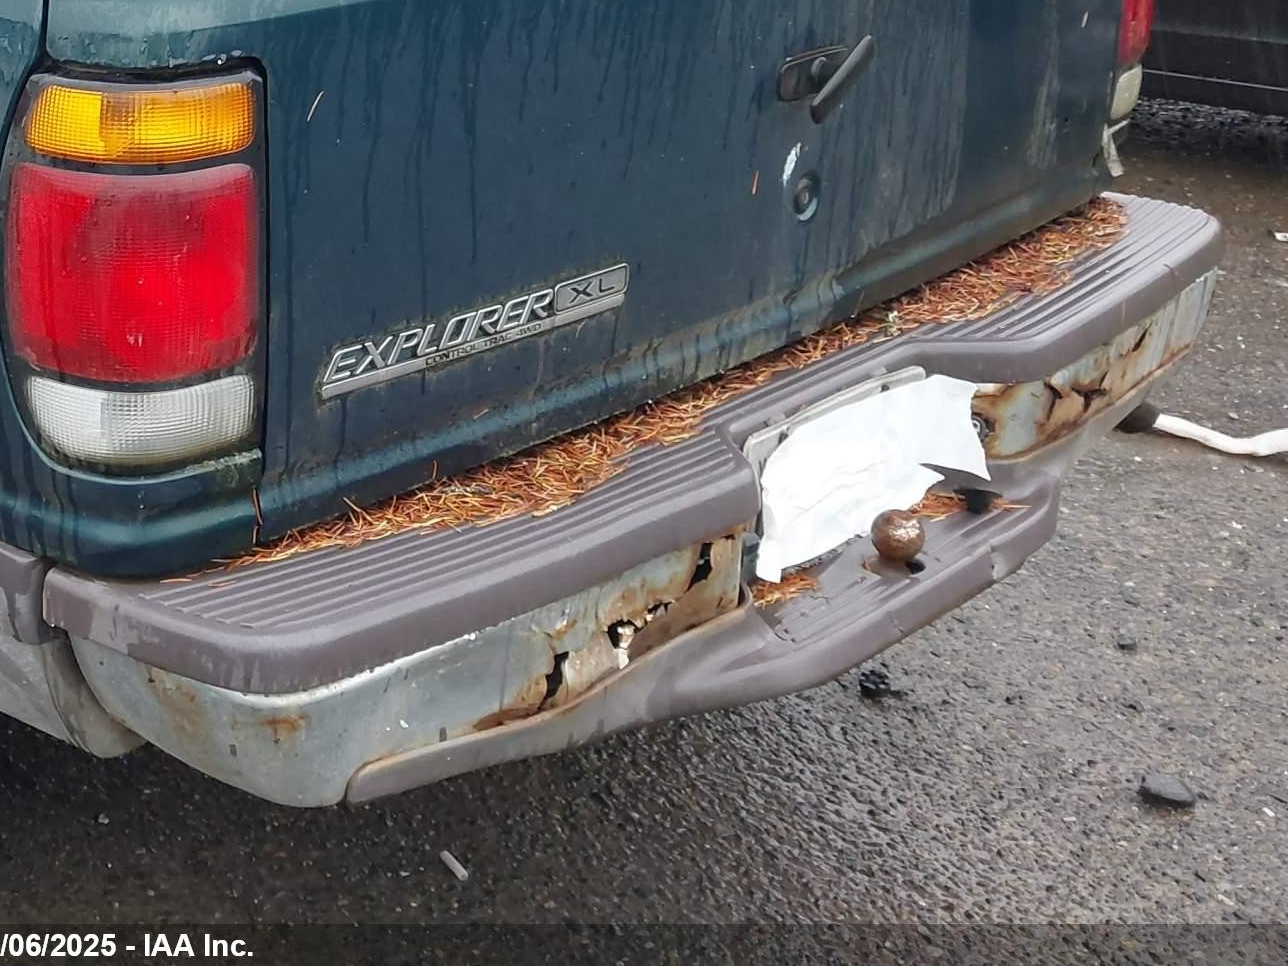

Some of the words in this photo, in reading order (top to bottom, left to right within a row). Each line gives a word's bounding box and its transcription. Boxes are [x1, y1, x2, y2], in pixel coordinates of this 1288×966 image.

[323, 289, 555, 384] EXPLORER
[568, 278, 615, 304] XL
[425, 343, 480, 366] CONTROL
[482, 333, 513, 350] TRAC
[514, 323, 542, 339] 4WD
